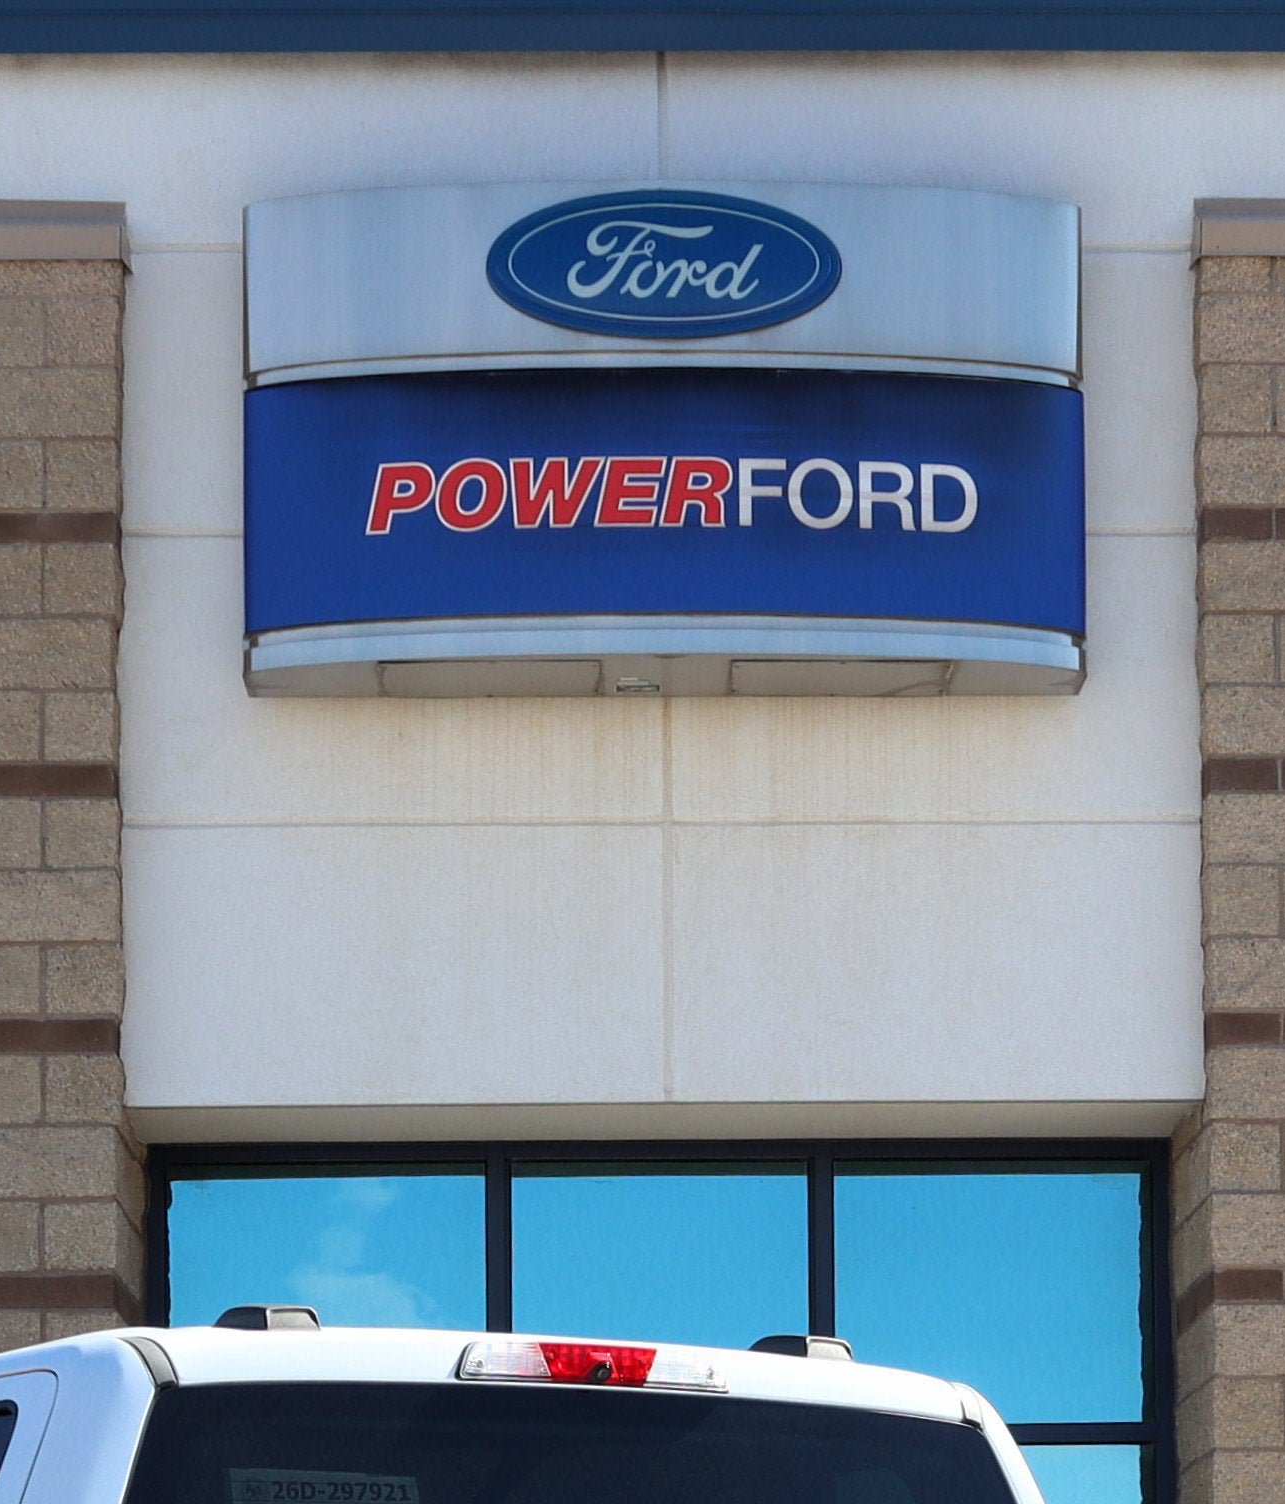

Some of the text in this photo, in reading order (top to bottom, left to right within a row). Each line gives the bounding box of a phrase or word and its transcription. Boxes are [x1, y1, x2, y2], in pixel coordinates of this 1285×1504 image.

[566, 219, 763, 302] Ford
[365, 455, 980, 537] POWERFORD
[271, 1480, 412, 1502] 26D-297921
